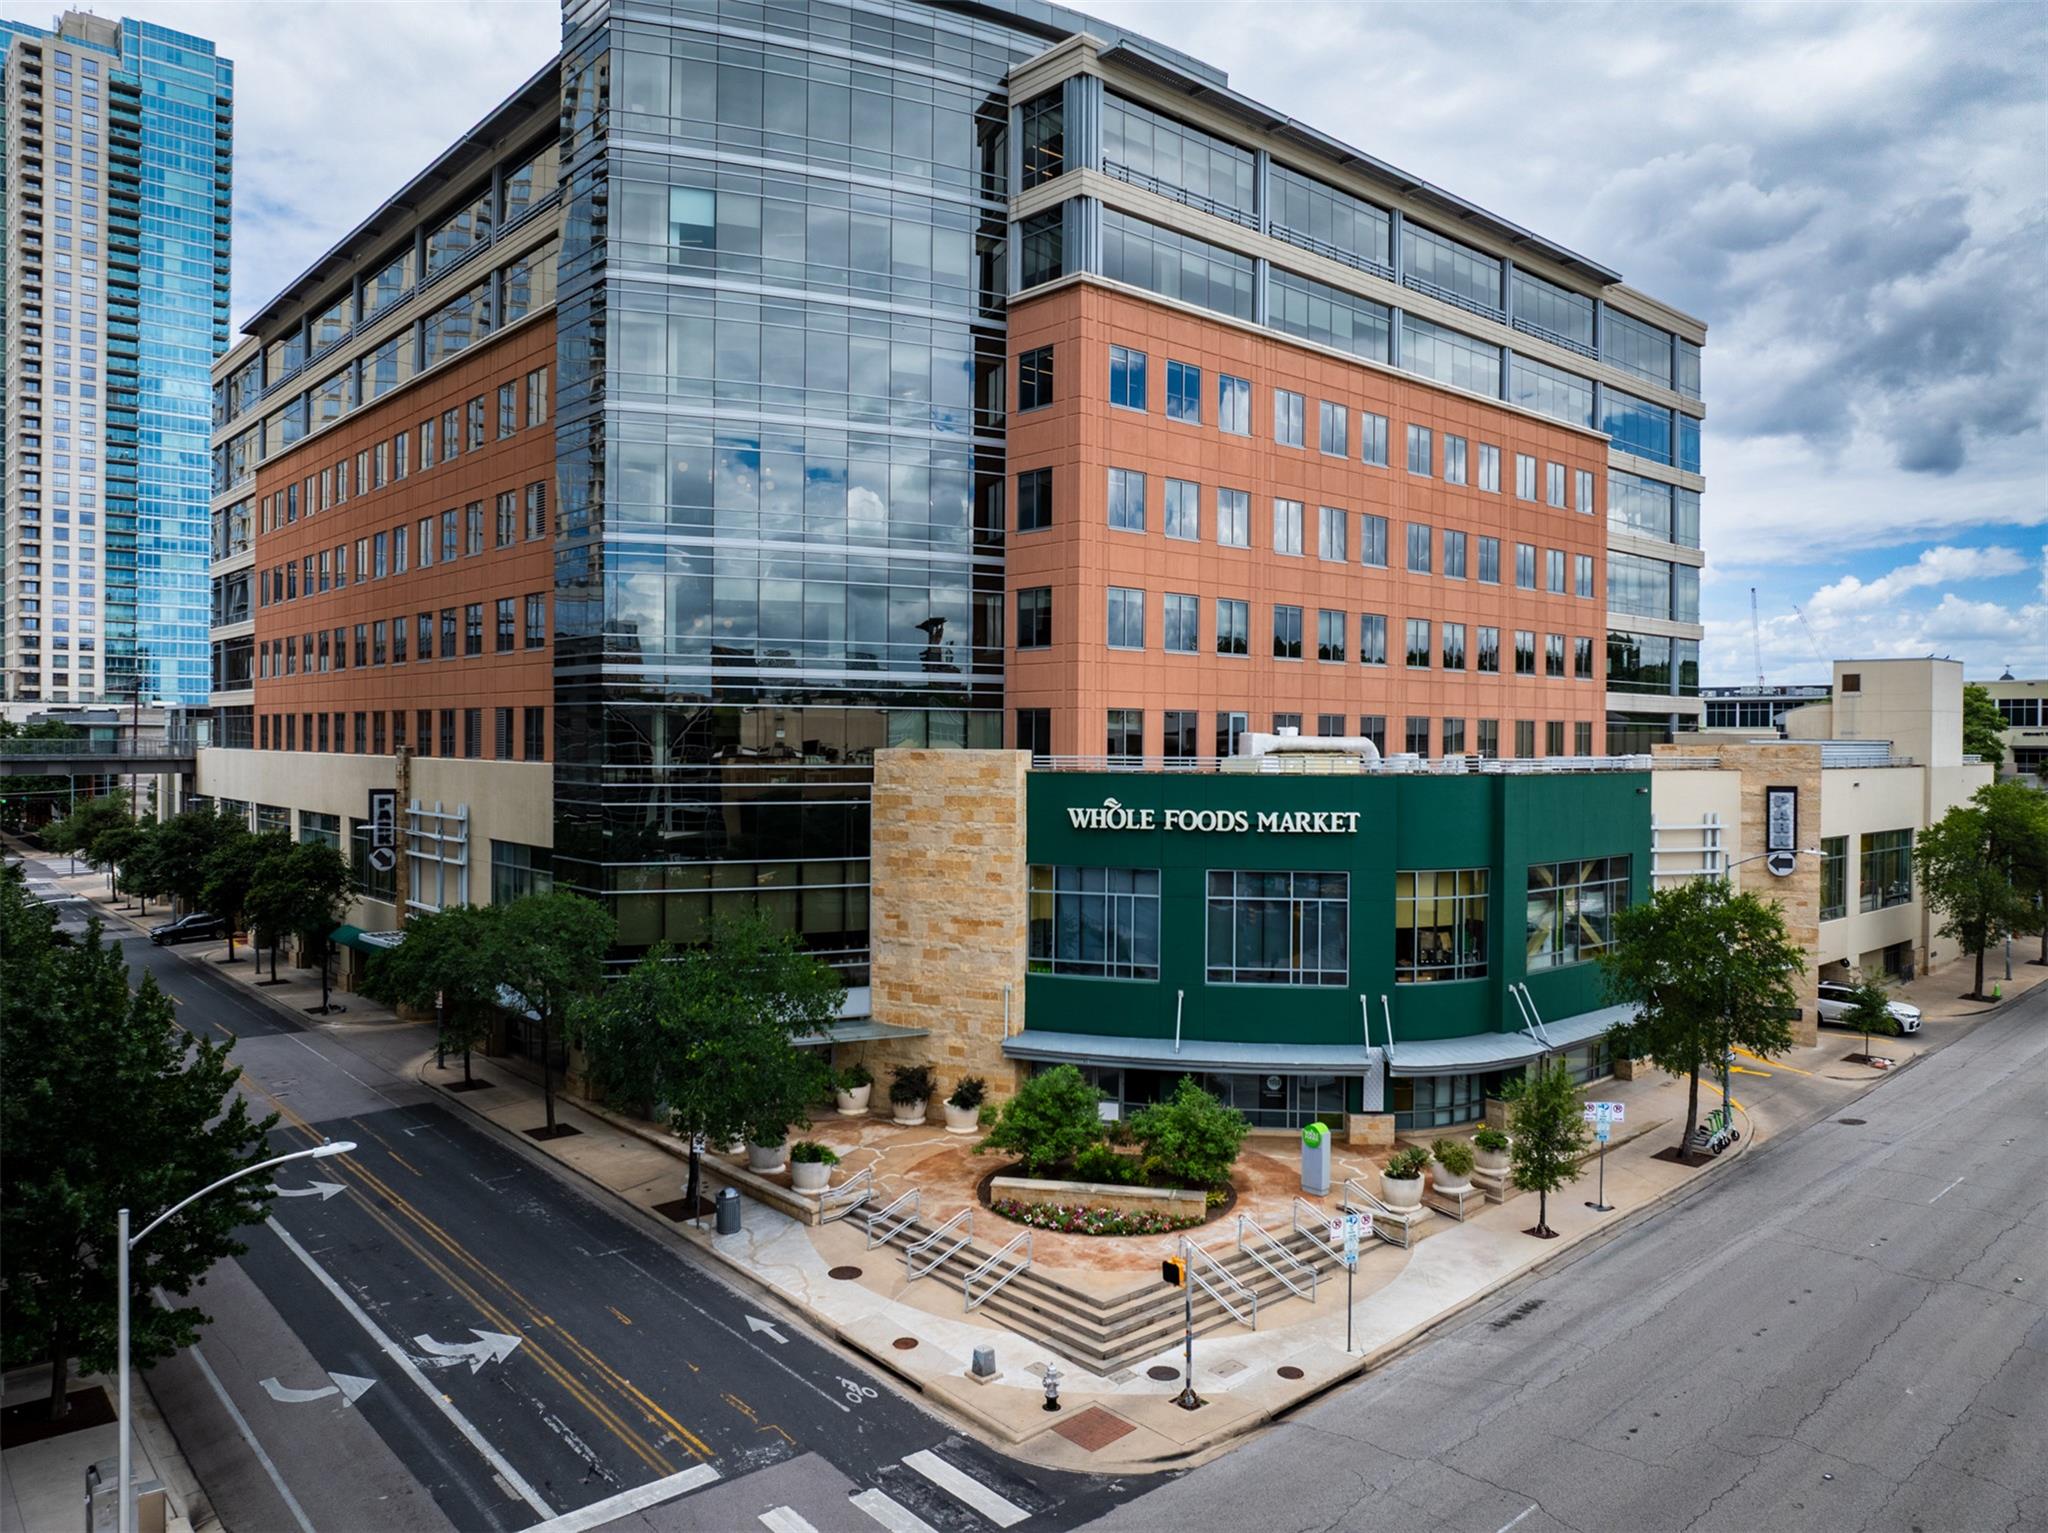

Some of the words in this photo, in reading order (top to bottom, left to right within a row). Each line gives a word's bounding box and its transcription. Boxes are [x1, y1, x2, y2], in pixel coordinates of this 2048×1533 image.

[377, 798, 392, 845] PARK
[1067, 798, 1155, 830] WHOLE
[1164, 810, 1249, 833] FOODS
[1256, 811, 1361, 833] MARKET
[1773, 795, 1790, 847] PARK
